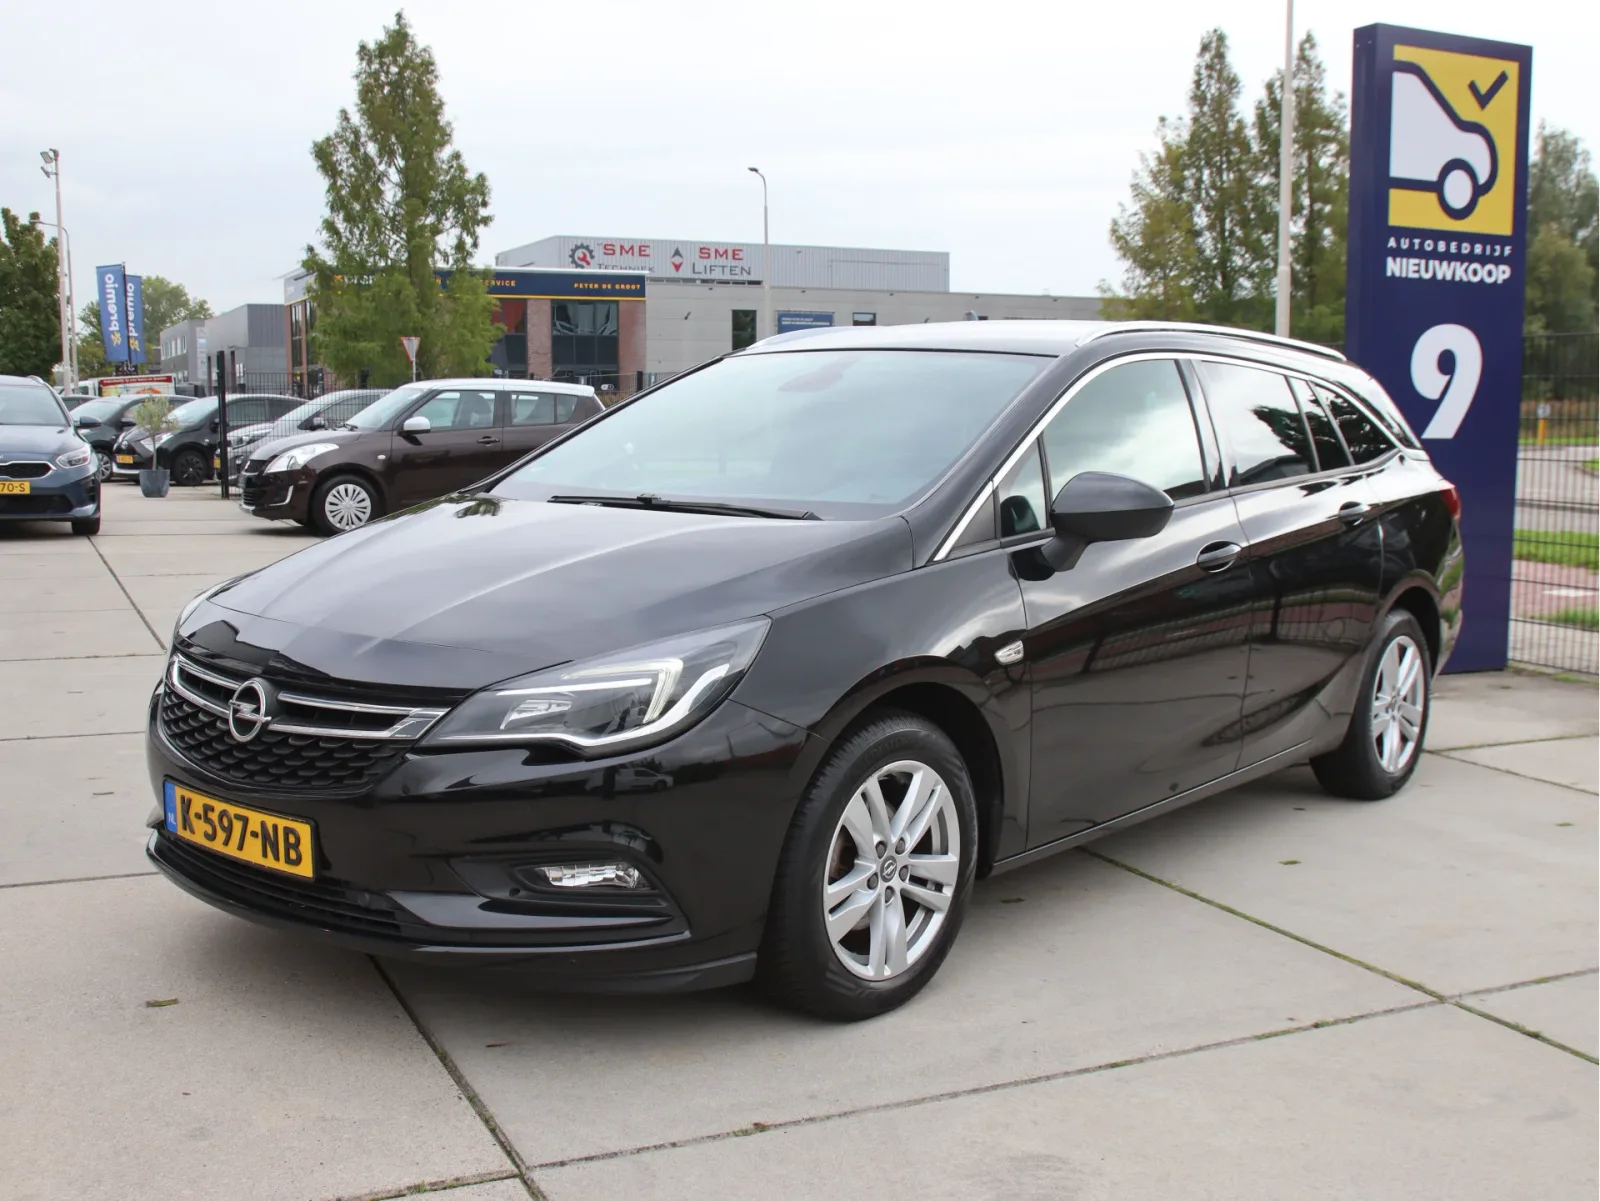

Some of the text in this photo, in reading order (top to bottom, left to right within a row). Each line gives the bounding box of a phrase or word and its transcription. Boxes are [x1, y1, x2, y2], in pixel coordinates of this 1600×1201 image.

[603, 243, 651, 257] SME
[698, 247, 744, 261] SME
[1387, 236, 1512, 257] AUTOBEDRIJF
[692, 262, 752, 276] LIFTEN
[1385, 256, 1512, 284] NIEUWKOOP
[573, 282, 599, 290] PETER
[126, 282, 139, 337] premio
[1410, 323, 1482, 439] 9
[180, 794, 302, 867] K-597-NB
